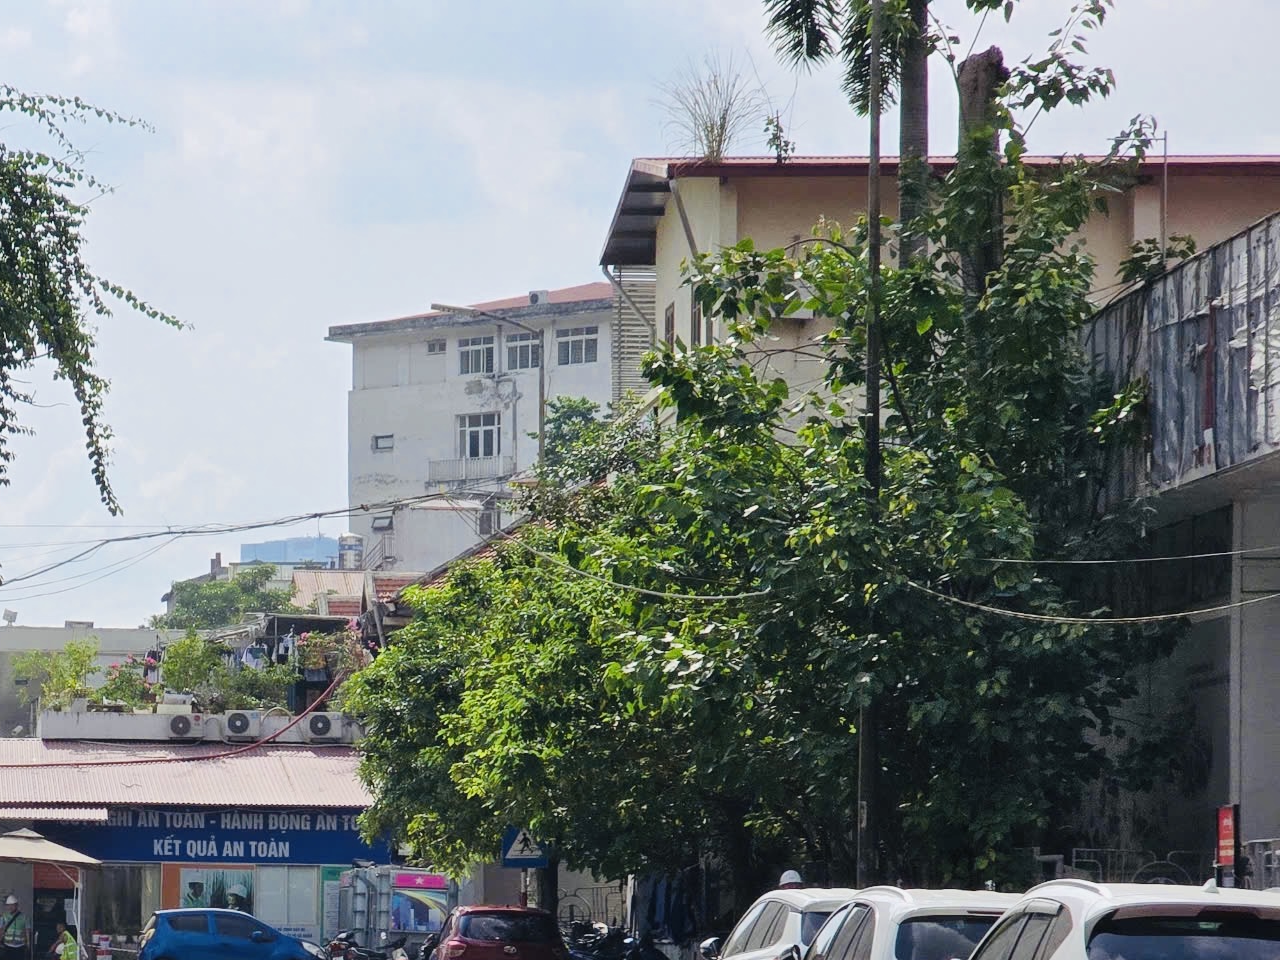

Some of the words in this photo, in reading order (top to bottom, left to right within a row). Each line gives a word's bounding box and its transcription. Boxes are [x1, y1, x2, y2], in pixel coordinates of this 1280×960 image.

[138, 811, 158, 828] AN
[166, 809, 205, 828] TOÀN
[221, 810, 263, 830] HÀNH
[268, 811, 310, 833] ĐỘNG
[315, 815, 337, 831] AN
[153, 834, 182, 856] KẾT
[186, 835, 218, 858] QUẢ
[222, 841, 244, 857] AN
[249, 838, 289, 858] TOÀN
